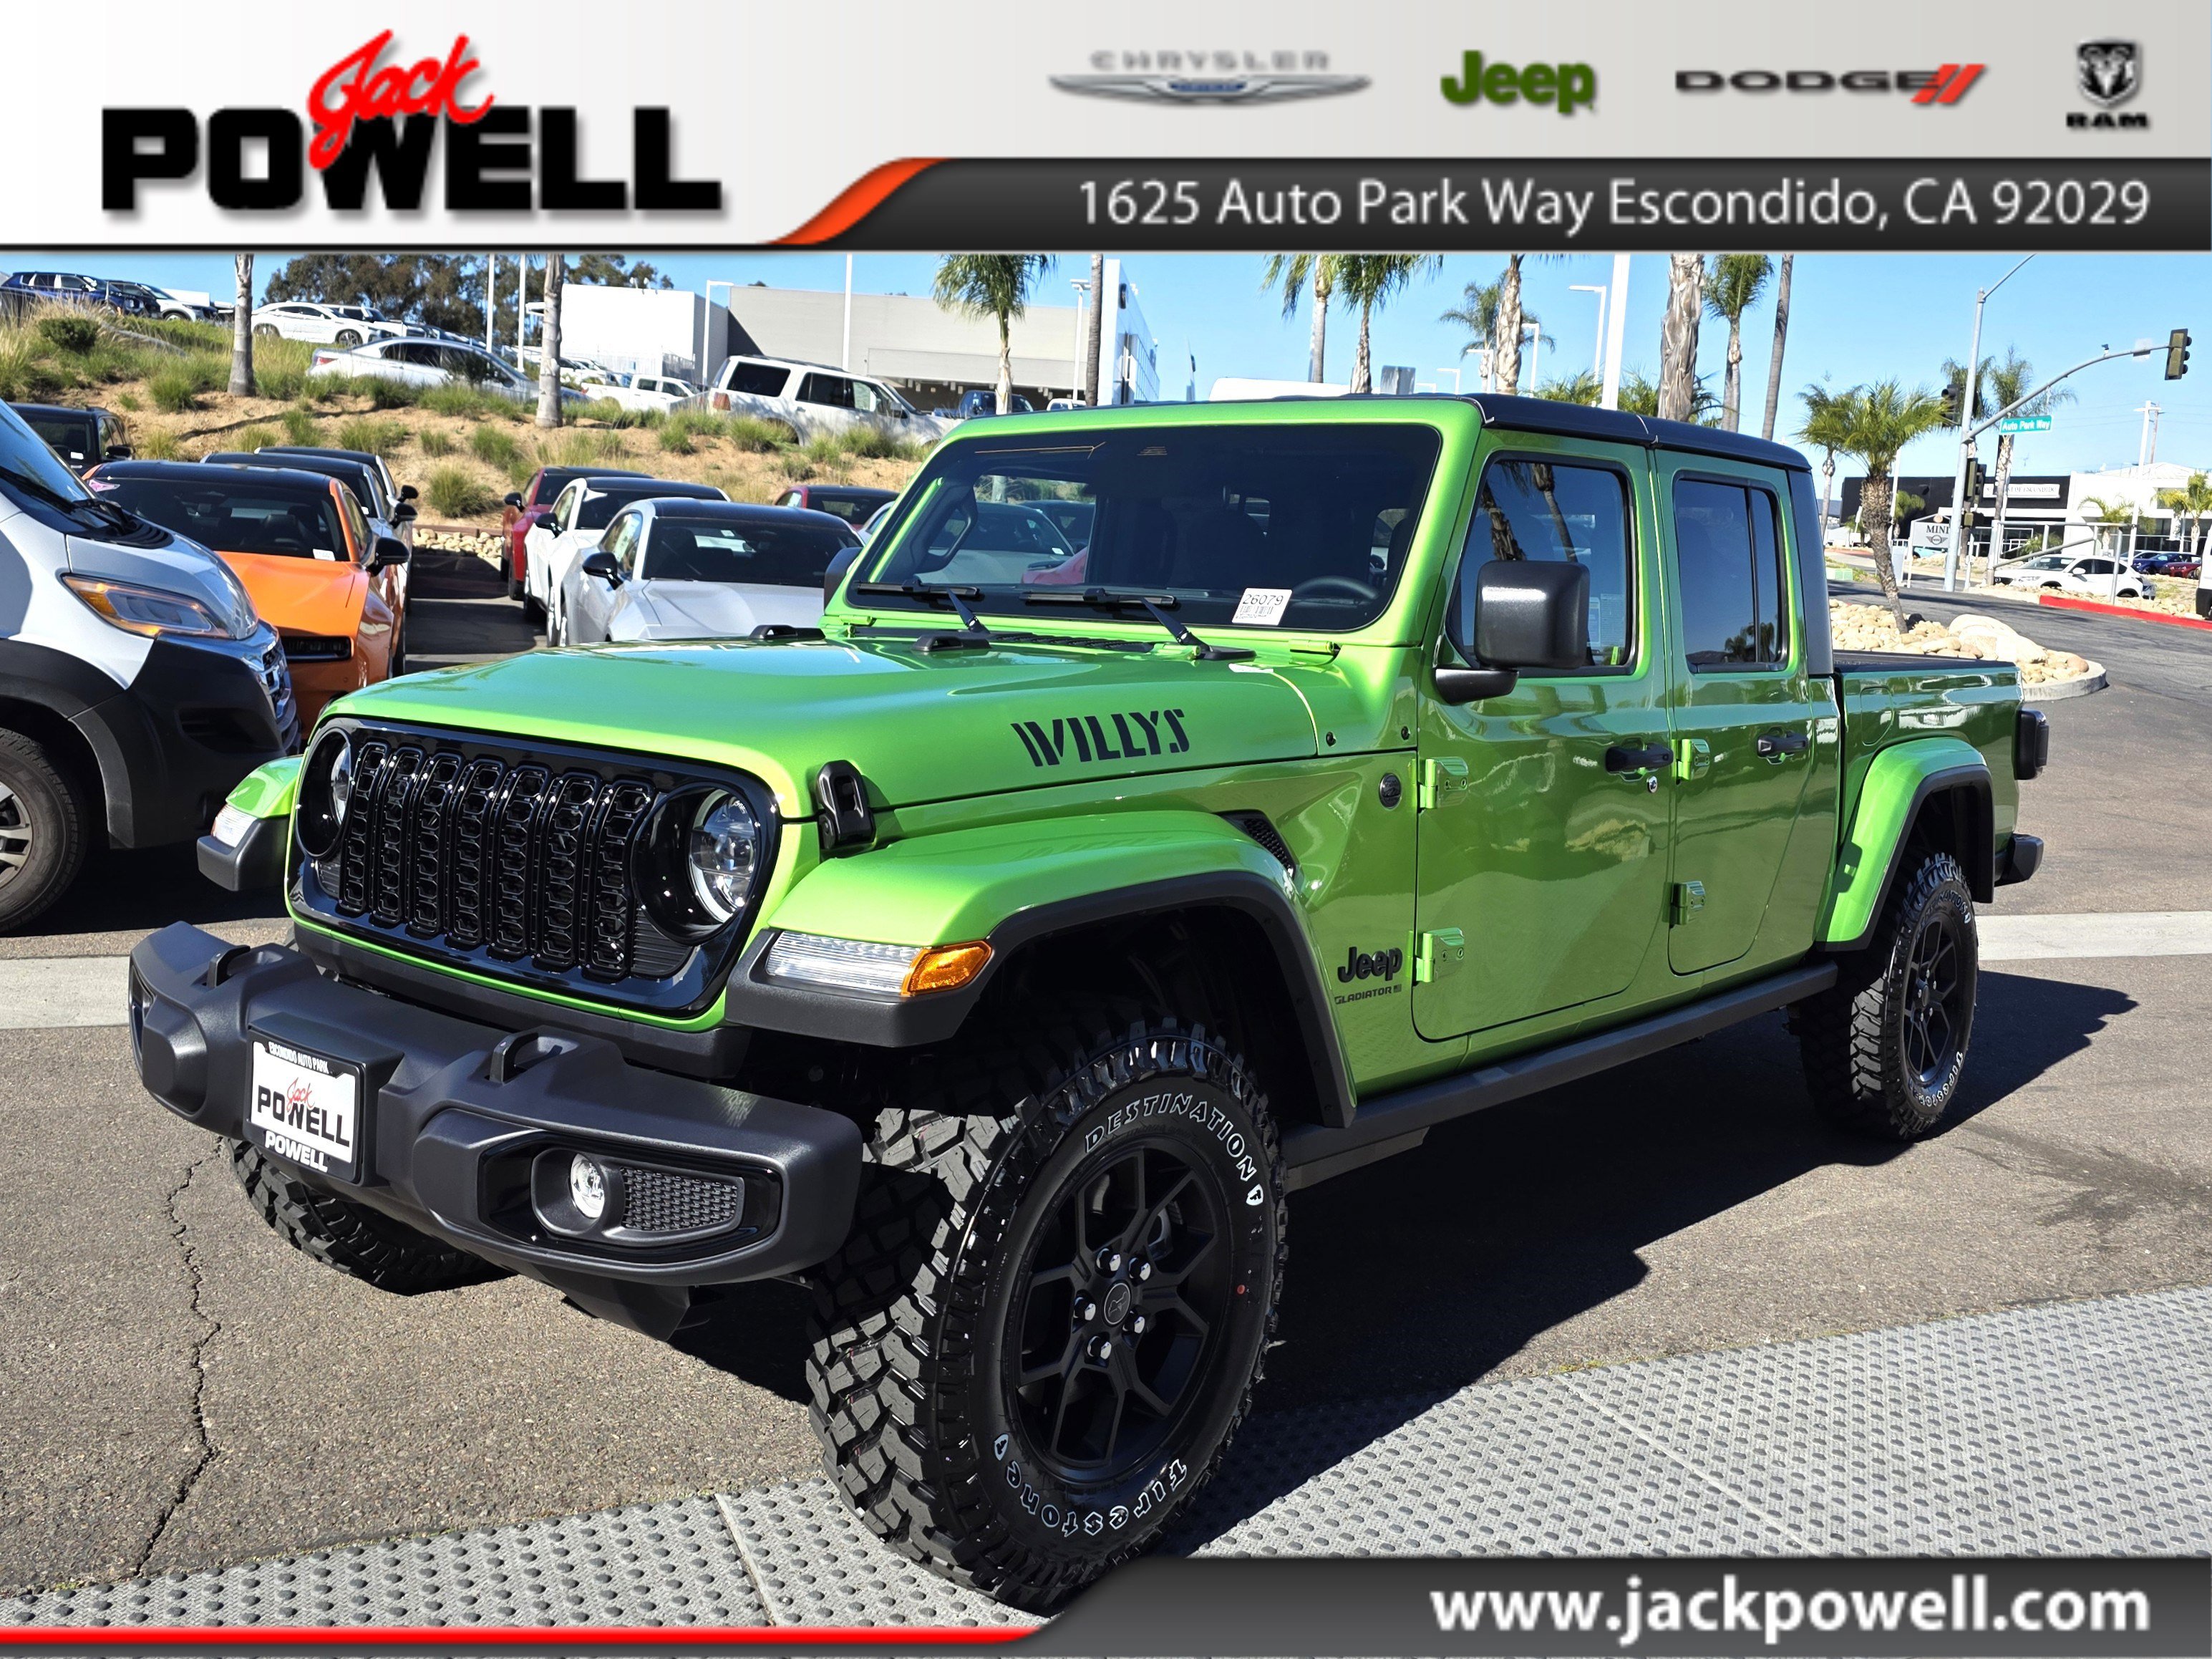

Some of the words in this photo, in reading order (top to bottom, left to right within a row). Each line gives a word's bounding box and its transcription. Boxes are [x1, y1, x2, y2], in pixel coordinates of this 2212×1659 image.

[2002, 421, 2018, 431] Auto
[2019, 420, 2035, 430] Park
[2036, 419, 2051, 430] Way
[1242, 594, 1284, 606] 26079
[1010, 709, 1190, 767] WILLYS
[1337, 946, 1403, 983] Jeep
[1334, 986, 1392, 1005] GLADIATOR
[297, 1052, 313, 1070] AUTO
[312, 1057, 330, 1075] PARK
[287, 1076, 316, 1111] Jack
[257, 1085, 350, 1148] POWELL
[264, 1130, 329, 1173] POWELL
[1085, 1093, 1257, 1182] DESTINATION
